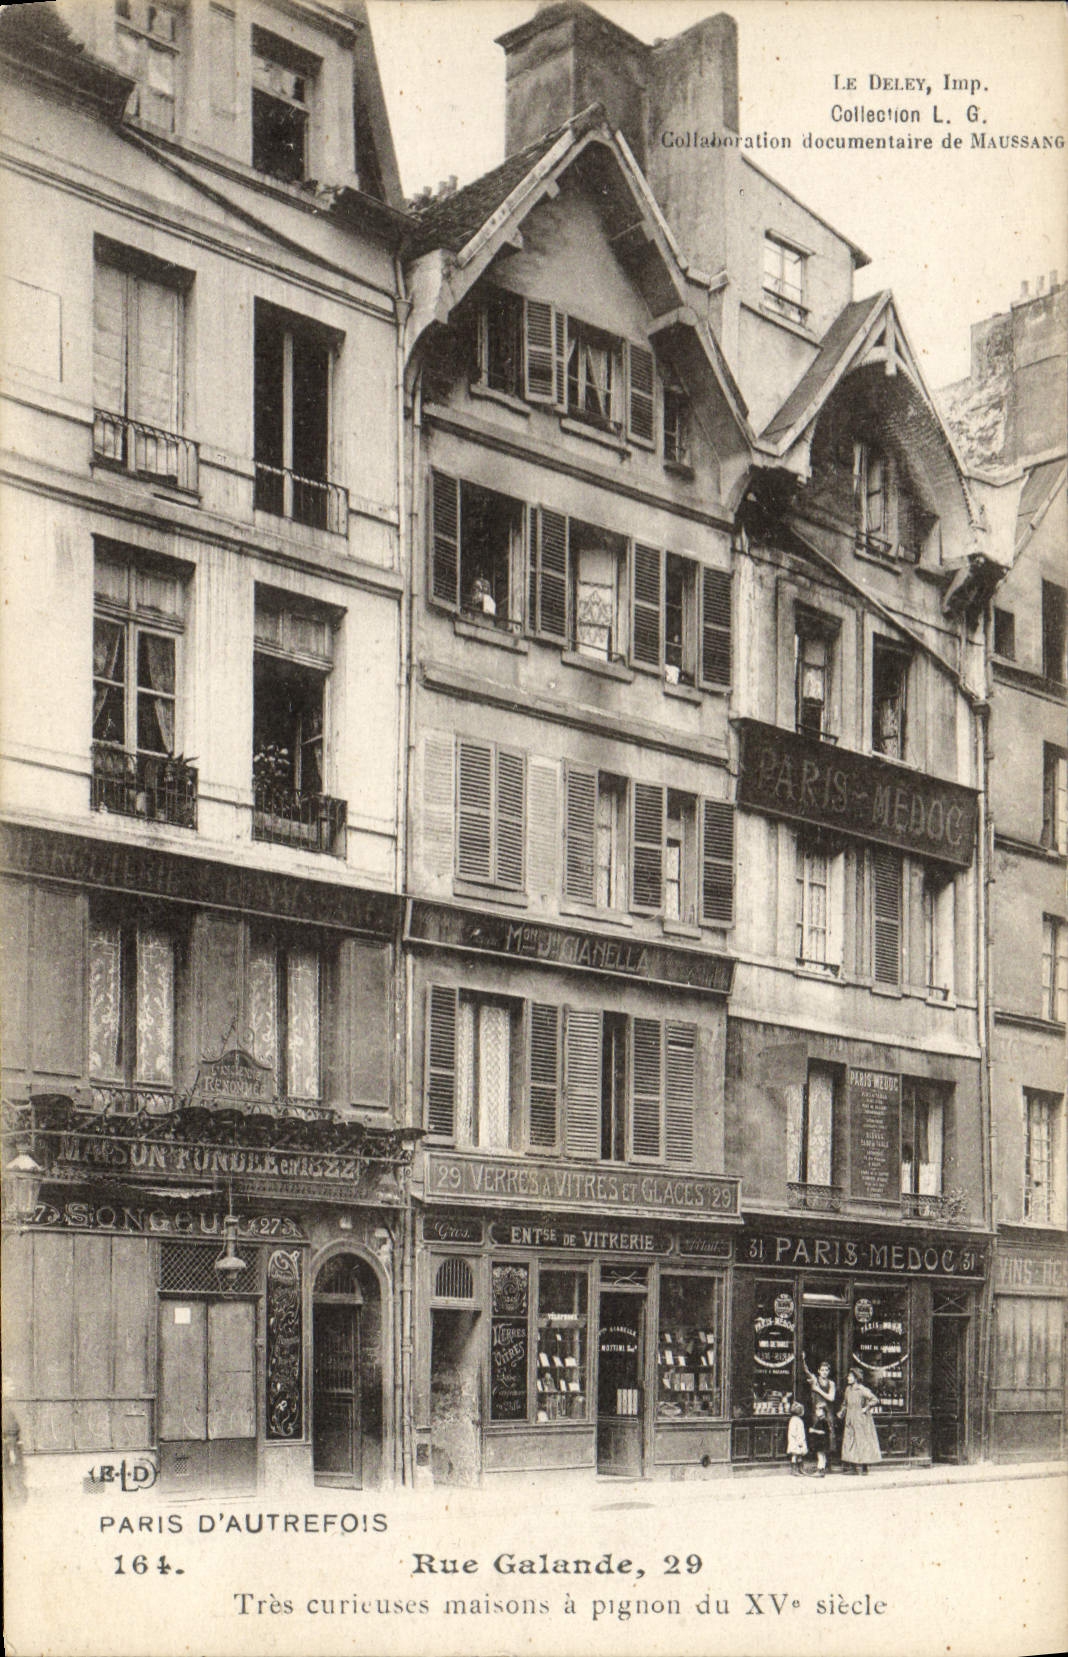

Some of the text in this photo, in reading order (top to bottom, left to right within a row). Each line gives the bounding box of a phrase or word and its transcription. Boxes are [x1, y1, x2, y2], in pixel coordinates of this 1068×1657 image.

[437, 1166, 461, 1188] 29
[469, 1164, 538, 1193] VERRES
[553, 1172, 617, 1200] VITRES
[622, 1183, 638, 1201] ET
[641, 1177, 704, 1207] GLACES
[713, 1187, 731, 1208] 29
[260, 1217, 280, 1235] 27
[563, 1232, 576, 1247] DE
[582, 1230, 655, 1250] VITRERIE
[750, 1239, 763, 1258] 31
[962, 1252, 975, 1270] 31
